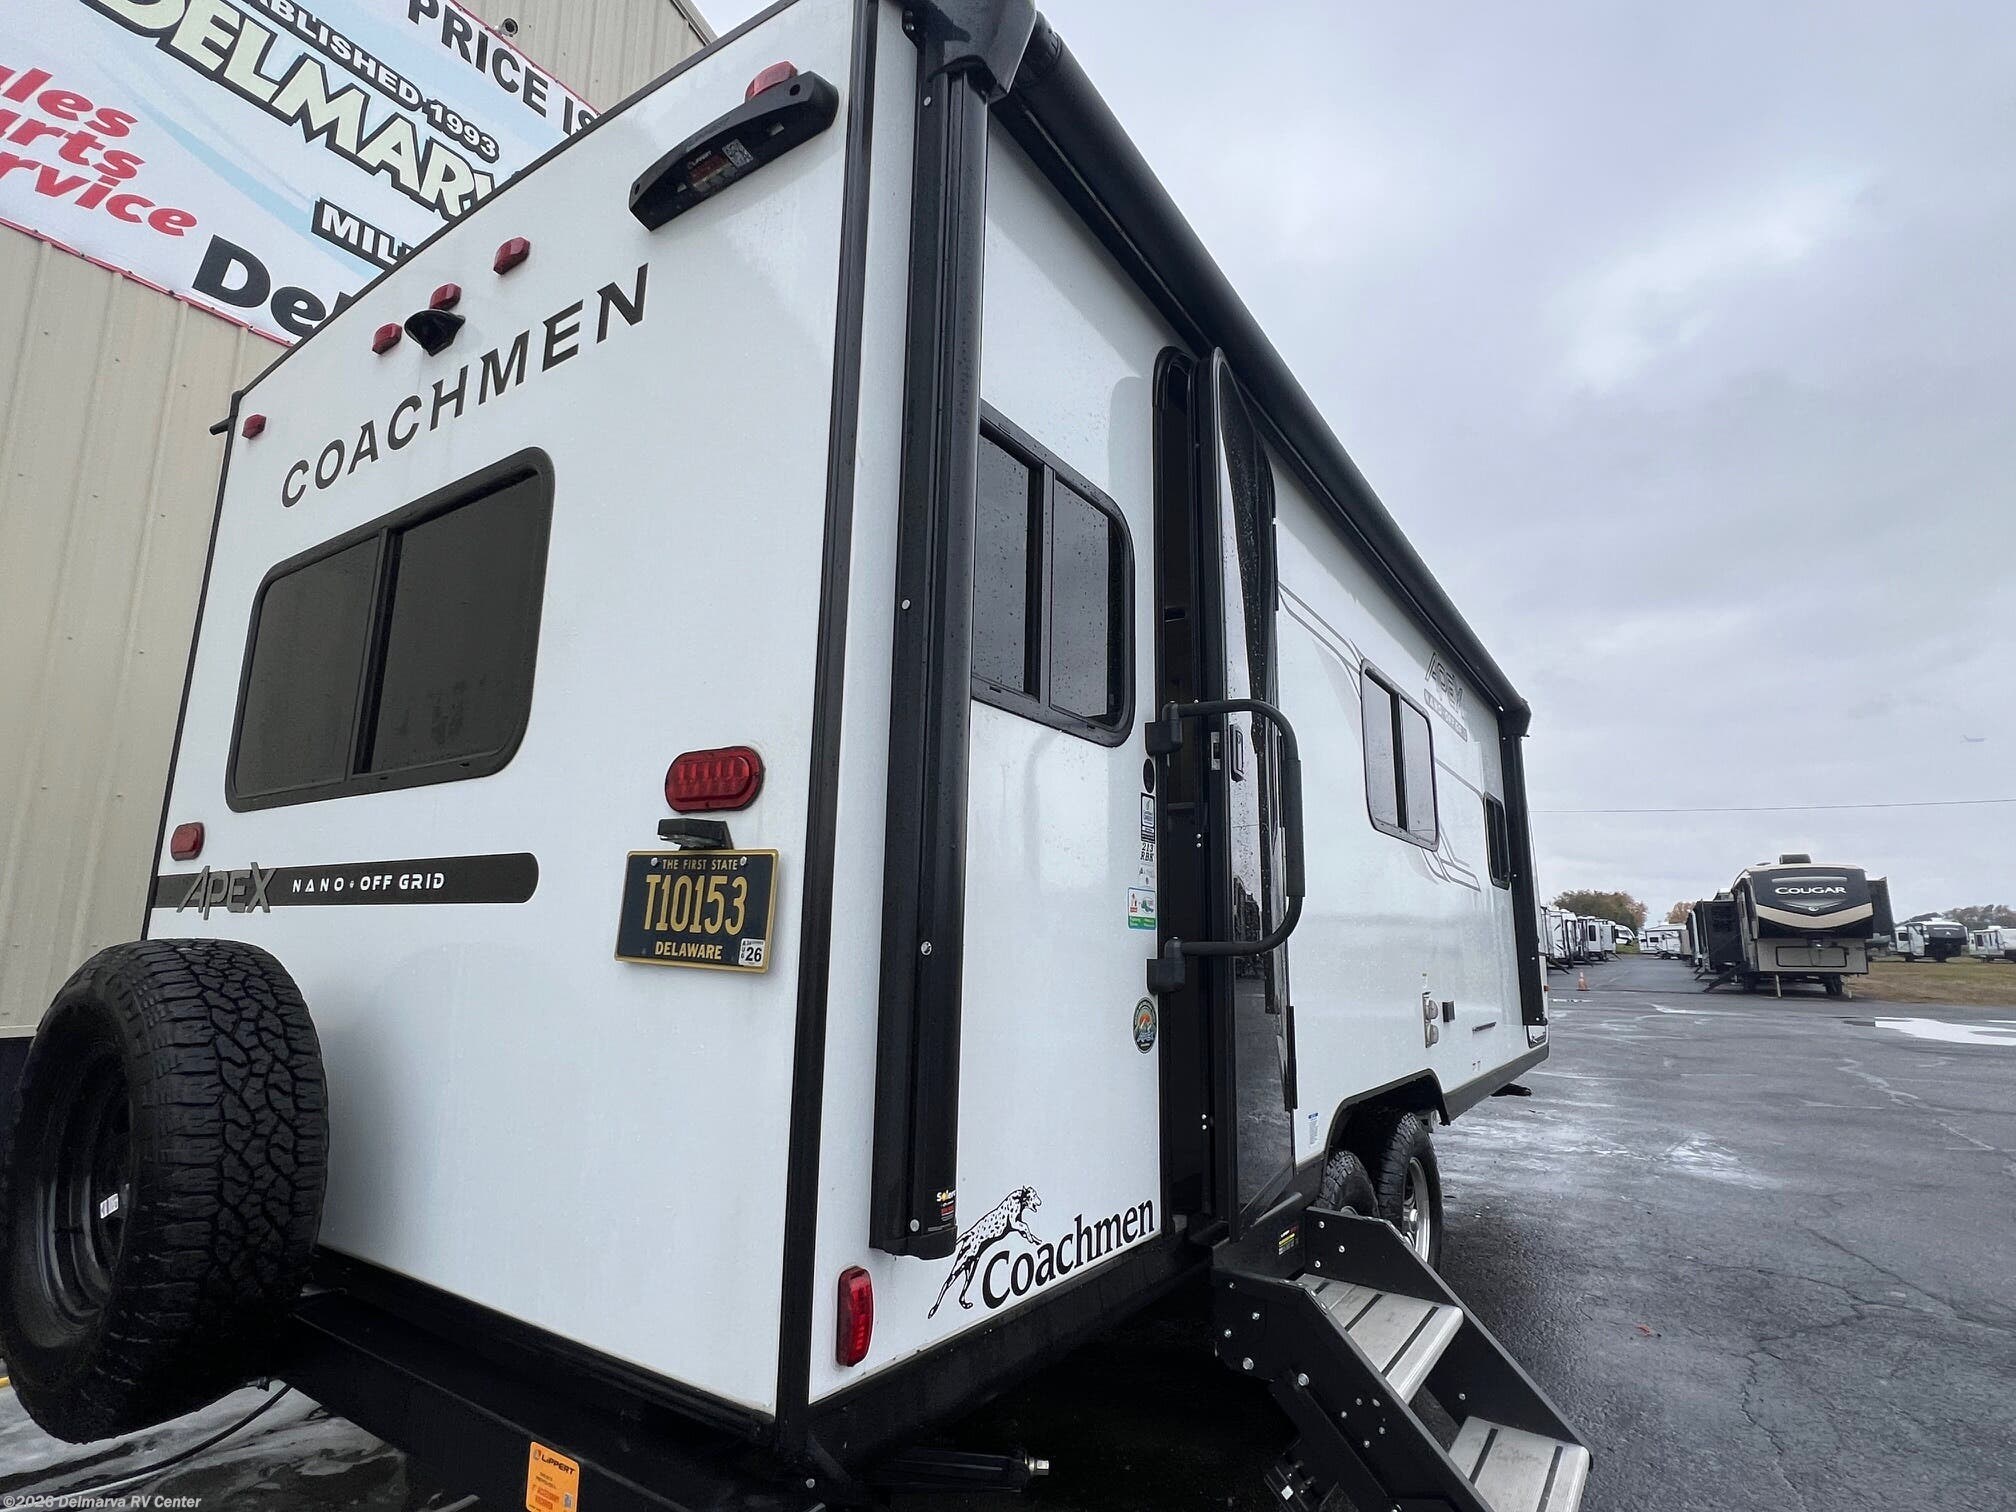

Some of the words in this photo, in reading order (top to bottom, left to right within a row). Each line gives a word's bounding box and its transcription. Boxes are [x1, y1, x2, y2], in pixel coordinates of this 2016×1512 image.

[259, 0, 420, 105] BLISHED
[427, 102, 498, 160] 1993
[407, 0, 549, 119] PRICE
[320, 203, 412, 266] MIL
[192, 234, 353, 338] De
[280, 262, 649, 508] COACHMEN
[175, 861, 278, 921] APEX
[291, 876, 346, 894] NANO
[359, 873, 394, 892] OFF
[398, 872, 446, 890] GRID
[661, 858, 679, 871] THE
[683, 858, 708, 871] FIRST
[711, 858, 738, 871] STATE
[1774, 886, 1847, 895] COUGAR
[643, 873, 749, 936] T10153
[654, 941, 723, 960] DELAWARE
[745, 946, 762, 962] 26
[982, 1199, 1155, 1309] Coachmen
